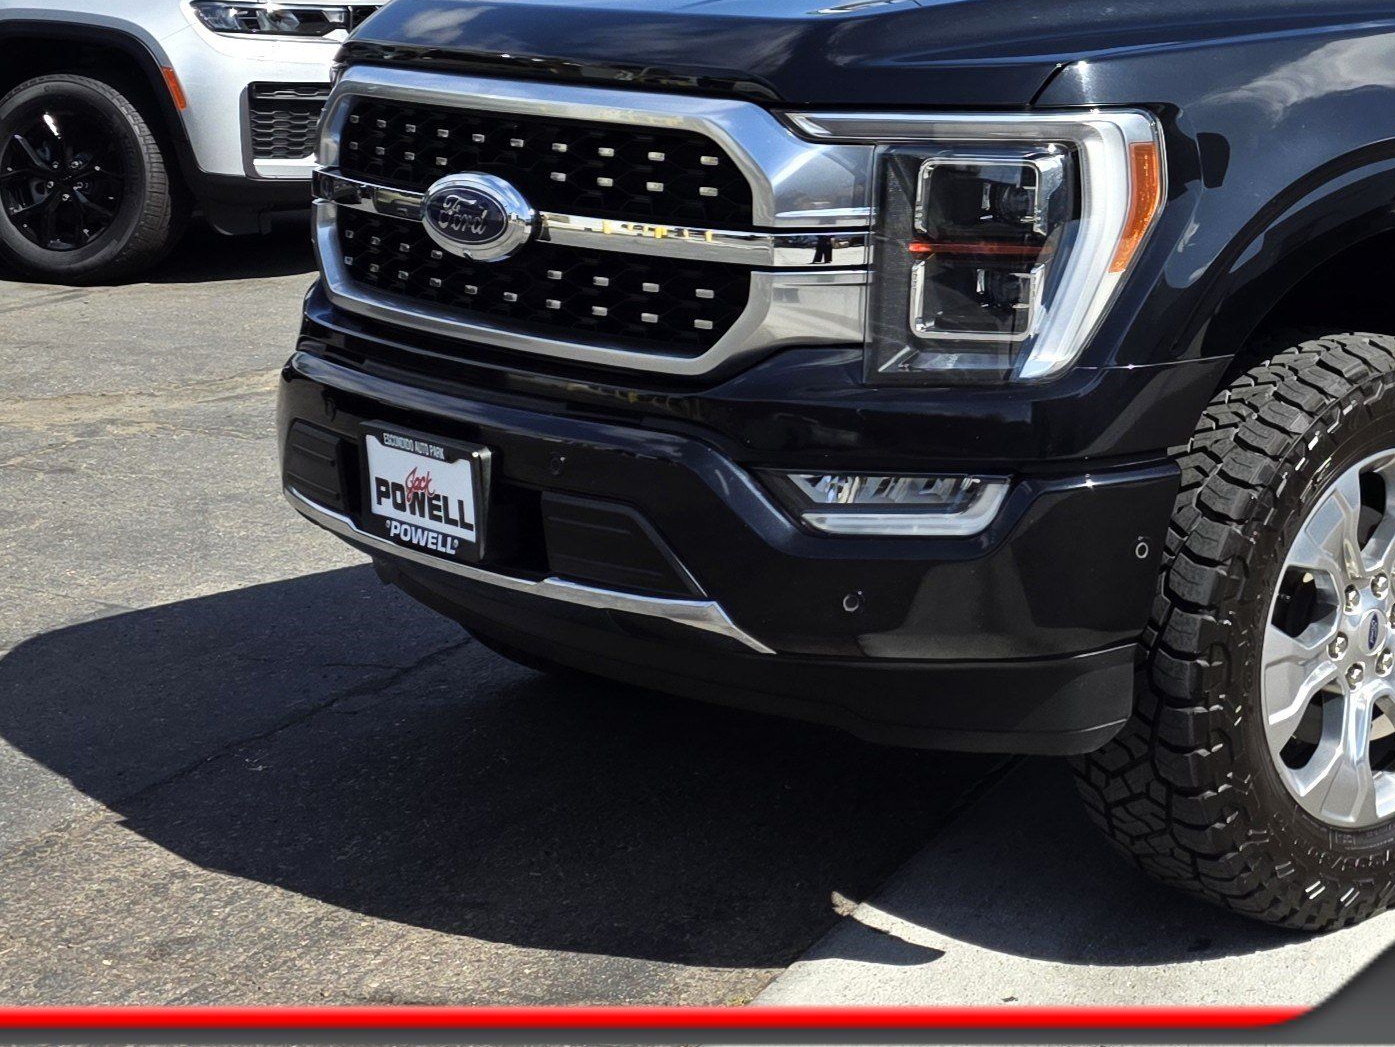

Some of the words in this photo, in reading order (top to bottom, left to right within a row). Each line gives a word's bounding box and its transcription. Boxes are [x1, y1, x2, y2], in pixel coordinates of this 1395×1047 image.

[437, 194, 488, 235] Ford
[383, 432, 414, 452] ESCONDIDO
[415, 441, 429, 455] AUTO
[429, 444, 445, 460] PARK
[375, 476, 474, 532] POWELL
[405, 467, 436, 503] Jack
